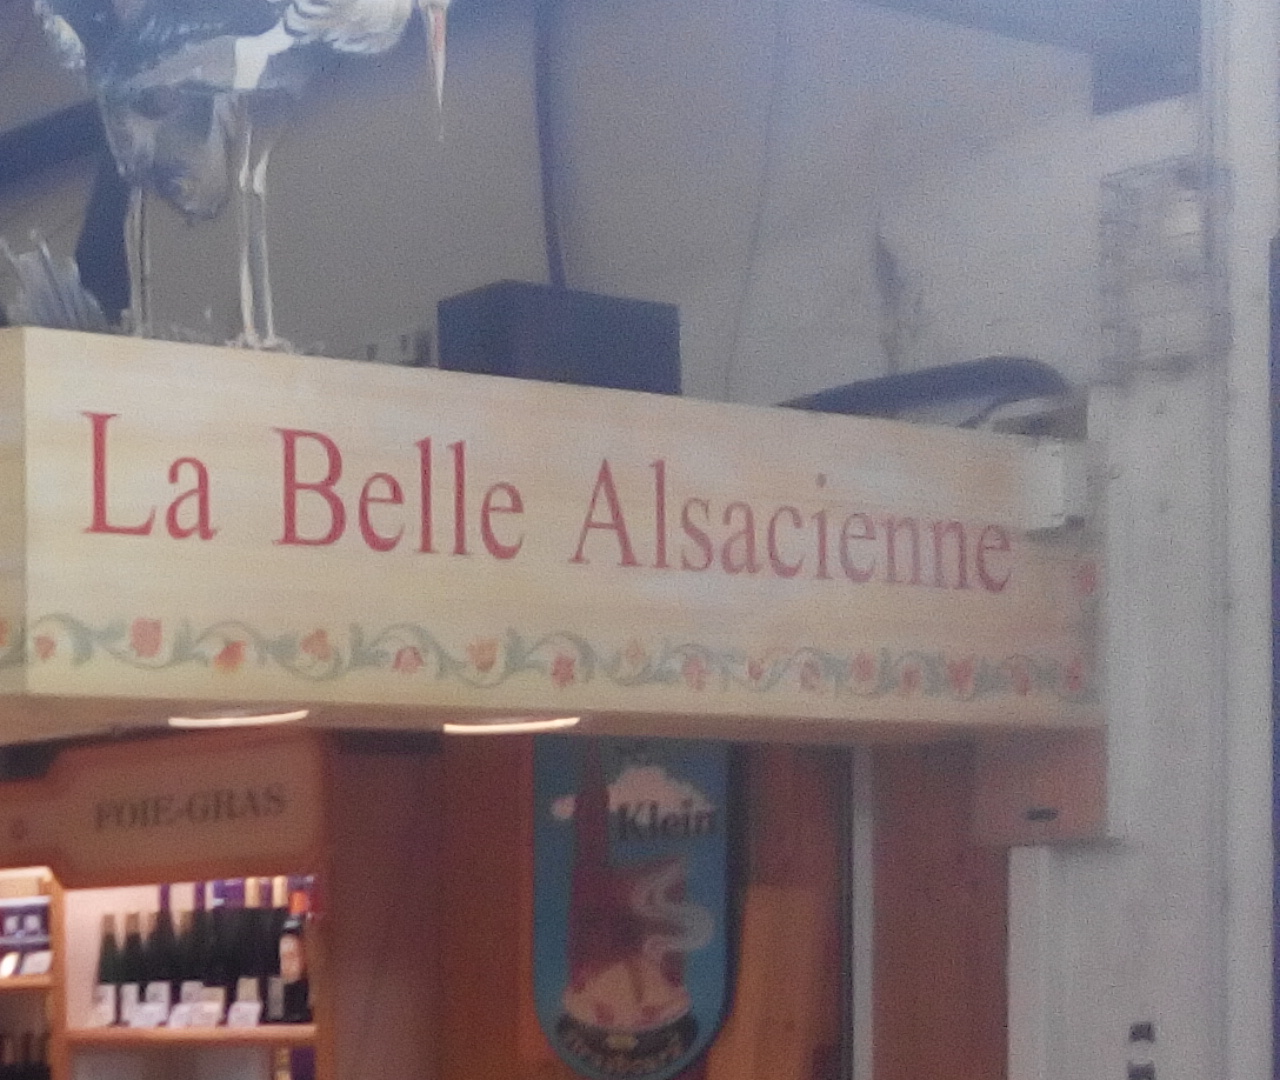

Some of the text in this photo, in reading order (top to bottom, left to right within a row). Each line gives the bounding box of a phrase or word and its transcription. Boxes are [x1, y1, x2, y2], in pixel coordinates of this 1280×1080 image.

[81, 410, 1013, 592] La Belle Alsacienne
[94, 781, 288, 832] FOIE-GRAS
